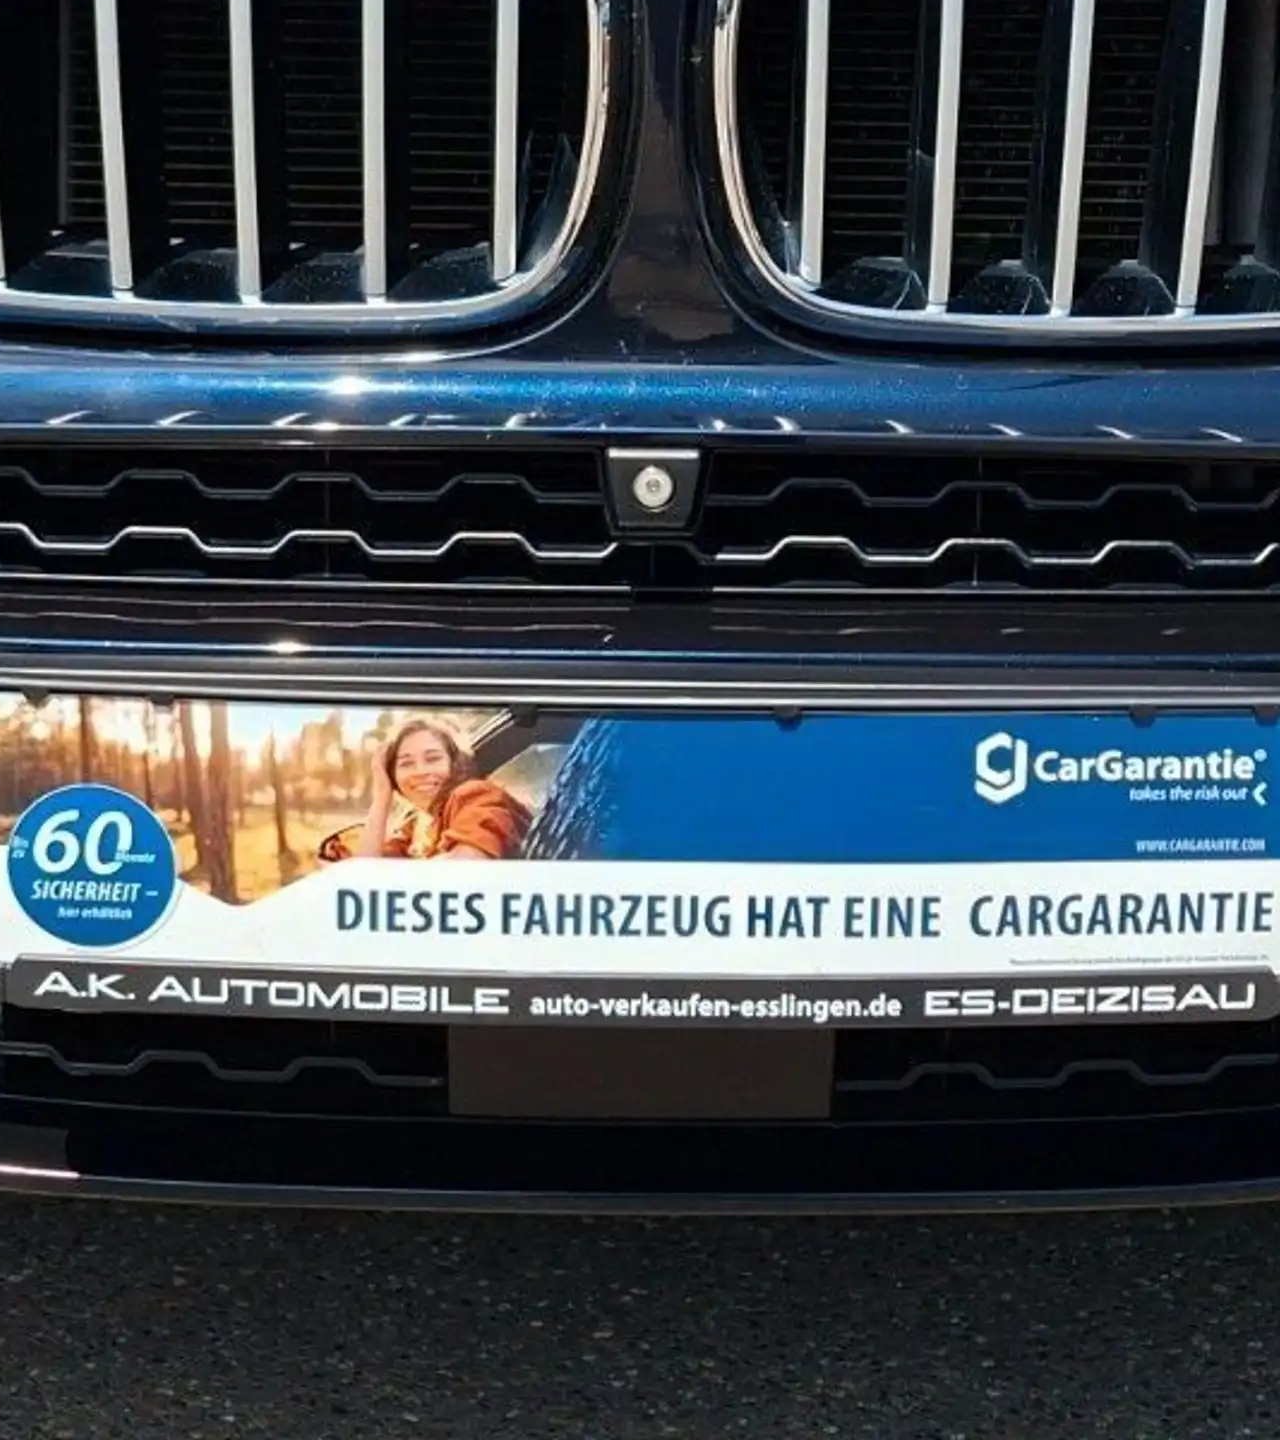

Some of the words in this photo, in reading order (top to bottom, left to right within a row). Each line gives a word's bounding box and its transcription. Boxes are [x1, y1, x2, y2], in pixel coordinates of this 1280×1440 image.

[1033, 748, 1257, 782] CarGarantie
[1129, 786, 1167, 801] takes
[1170, 785, 1193, 800] the
[1194, 785, 1219, 800] risk
[1222, 787, 1247, 800] out
[32, 809, 133, 875] 60
[30, 879, 142, 903] SICHERHEIT
[336, 888, 487, 935] DIESES
[500, 892, 732, 938] FAHRZEUG
[746, 895, 830, 939] HAT
[843, 895, 942, 938] EINE
[969, 891, 1276, 937] CARGARANTIE
[33, 970, 136, 1001] A.K.
[148, 973, 511, 1016] AUTOMOBILE
[529, 991, 902, 1024] auto-verkaufen-esslingen.de
[923, 982, 1256, 1018] ES-DEIZISAU
